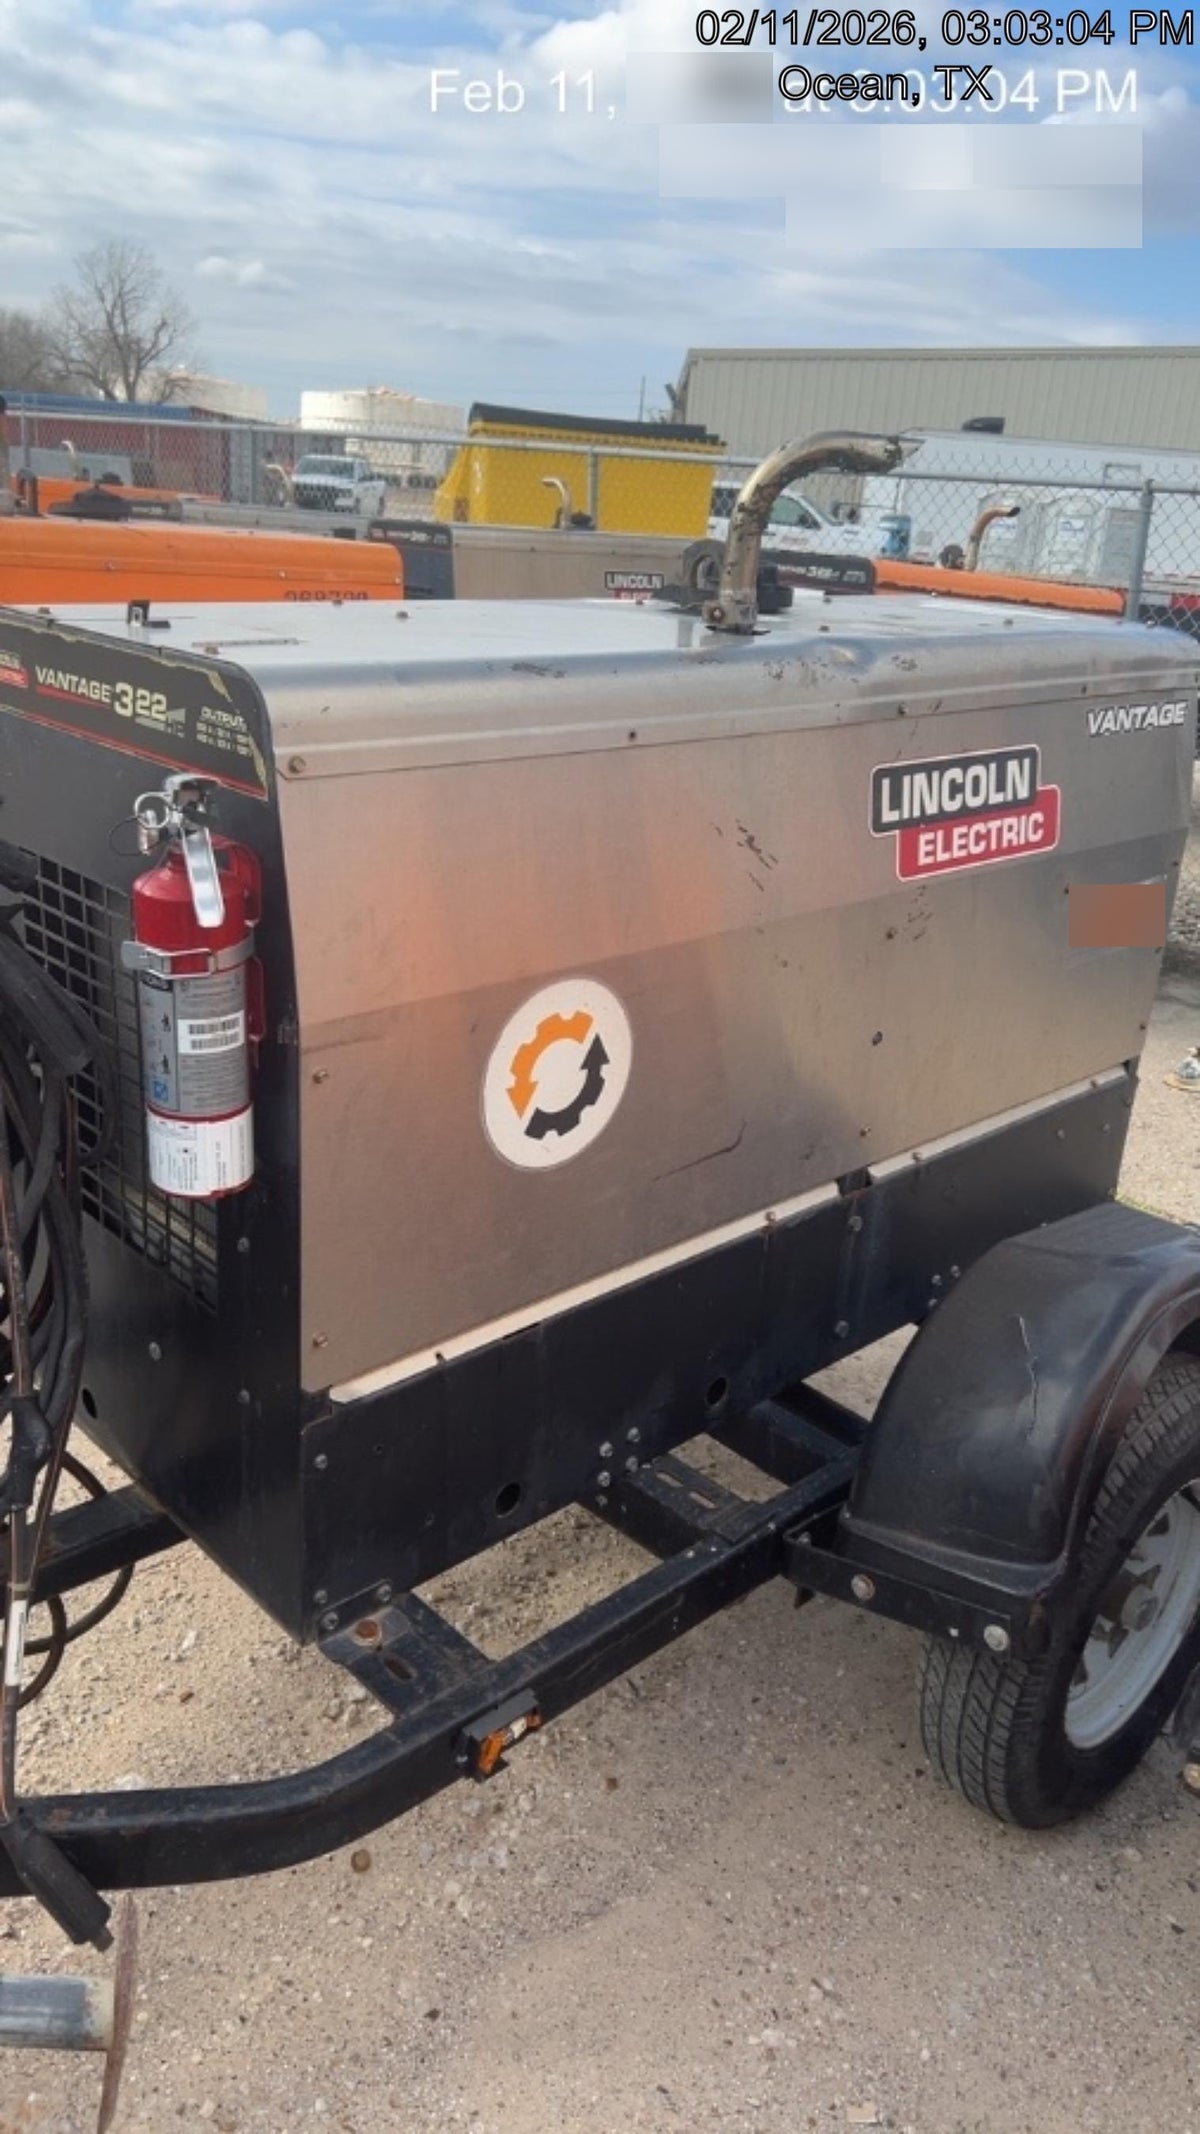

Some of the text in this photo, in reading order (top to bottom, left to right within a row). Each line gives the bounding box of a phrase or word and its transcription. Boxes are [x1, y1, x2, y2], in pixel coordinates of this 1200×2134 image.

[35, 664, 113, 704] VANTAGE
[113, 681, 168, 722] 322
[1086, 700, 1189, 738] VANTAGE
[880, 757, 1031, 824] LINCOLN
[916, 811, 1045, 867] ELECTRIC
